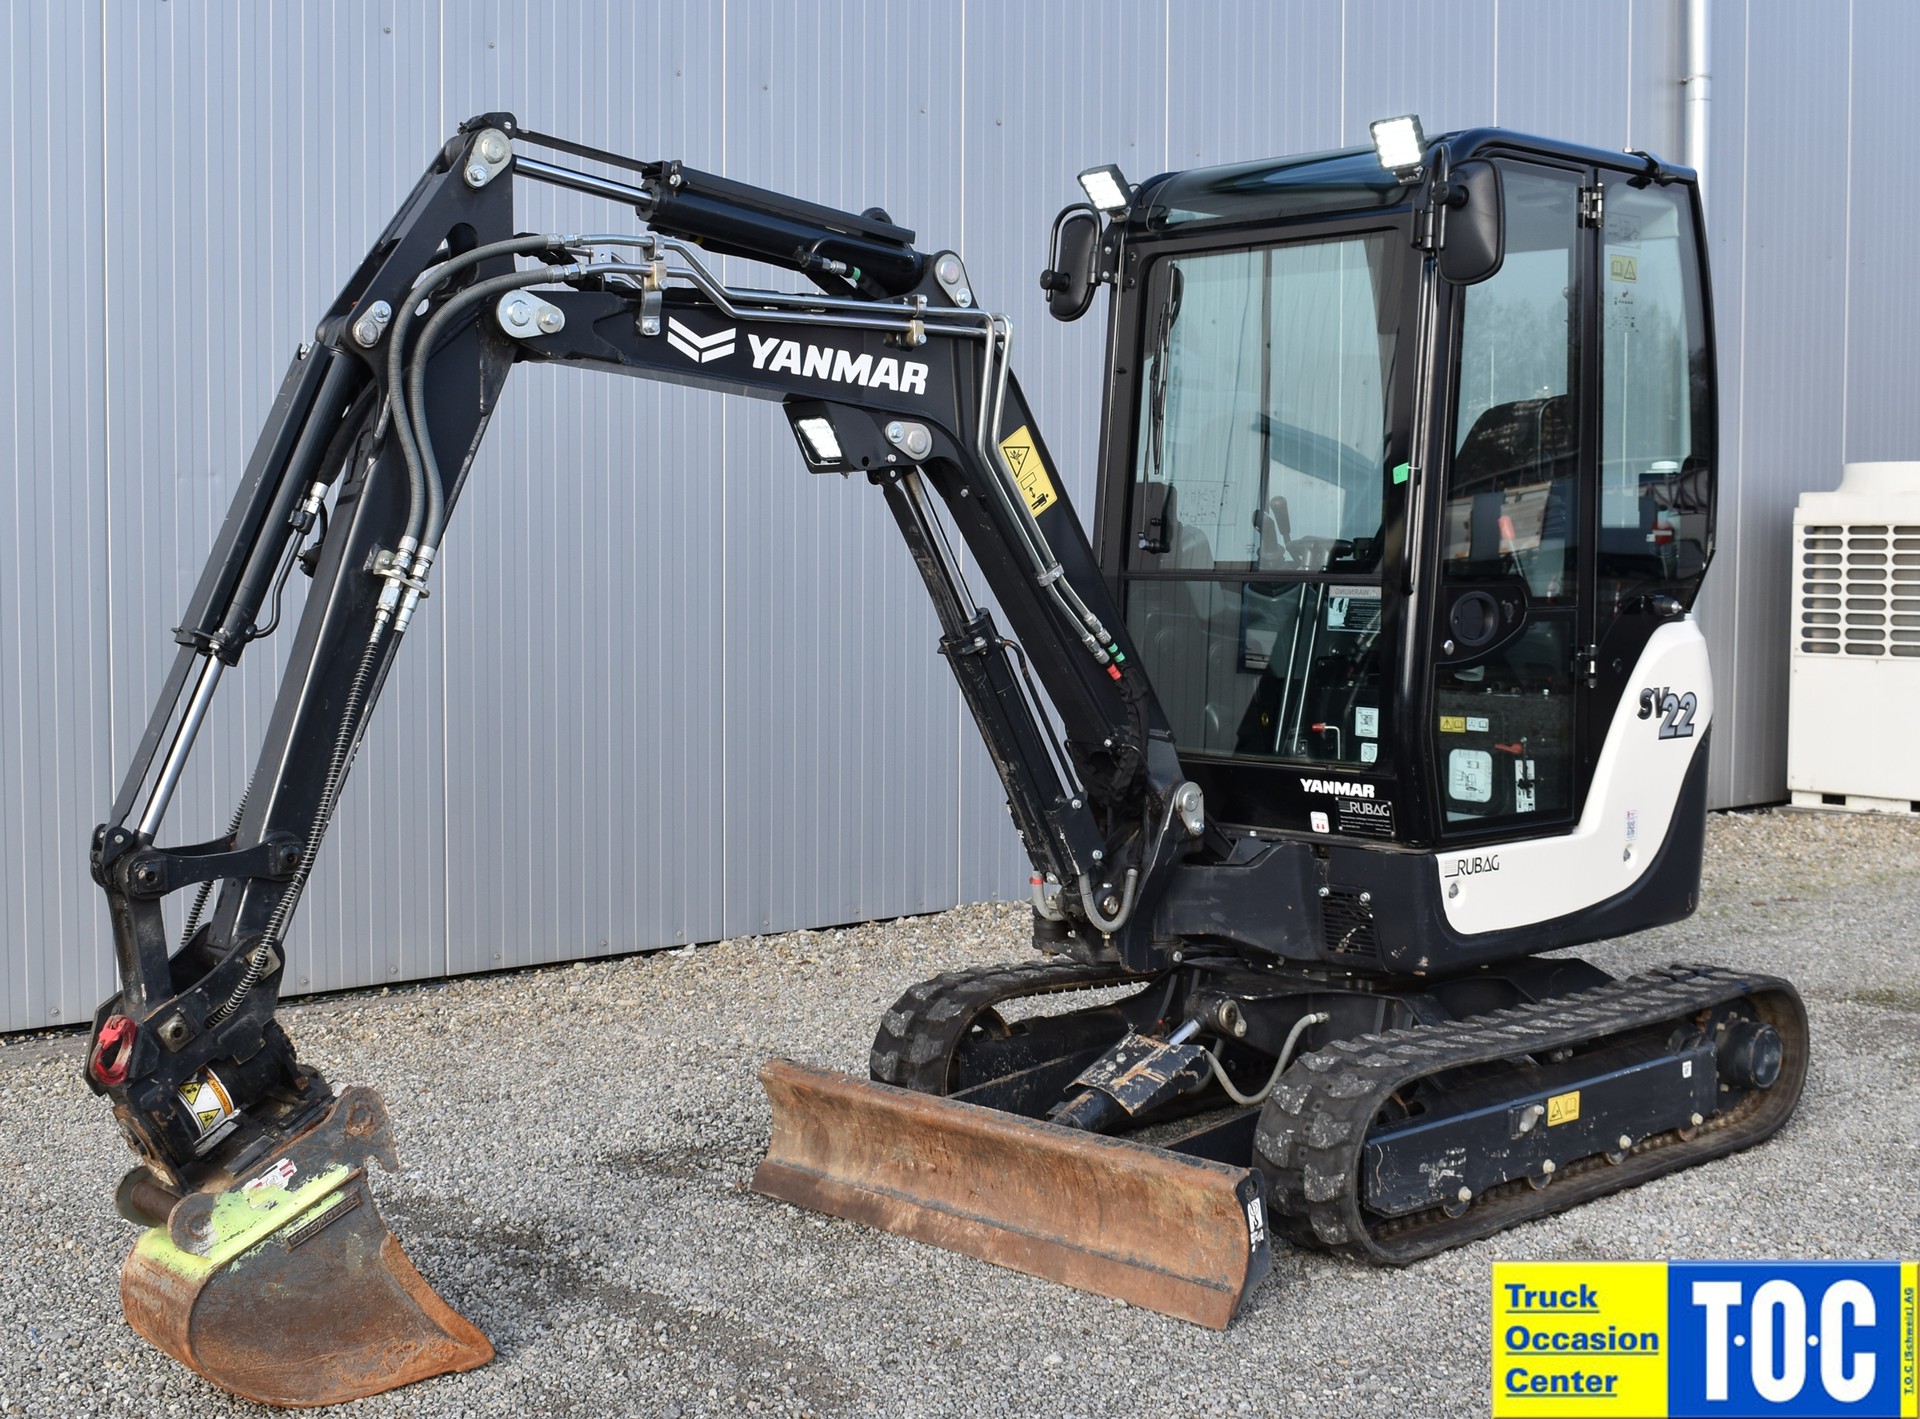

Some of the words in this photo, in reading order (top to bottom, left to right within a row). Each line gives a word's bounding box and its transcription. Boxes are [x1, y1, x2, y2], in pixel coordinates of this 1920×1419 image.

[747, 334, 929, 395] YANMAR
[1637, 686, 1697, 740] SV22
[1300, 778, 1375, 798] YANMAR
[1349, 801, 1390, 817] RUBAG
[1457, 854, 1500, 876] RUBAG
